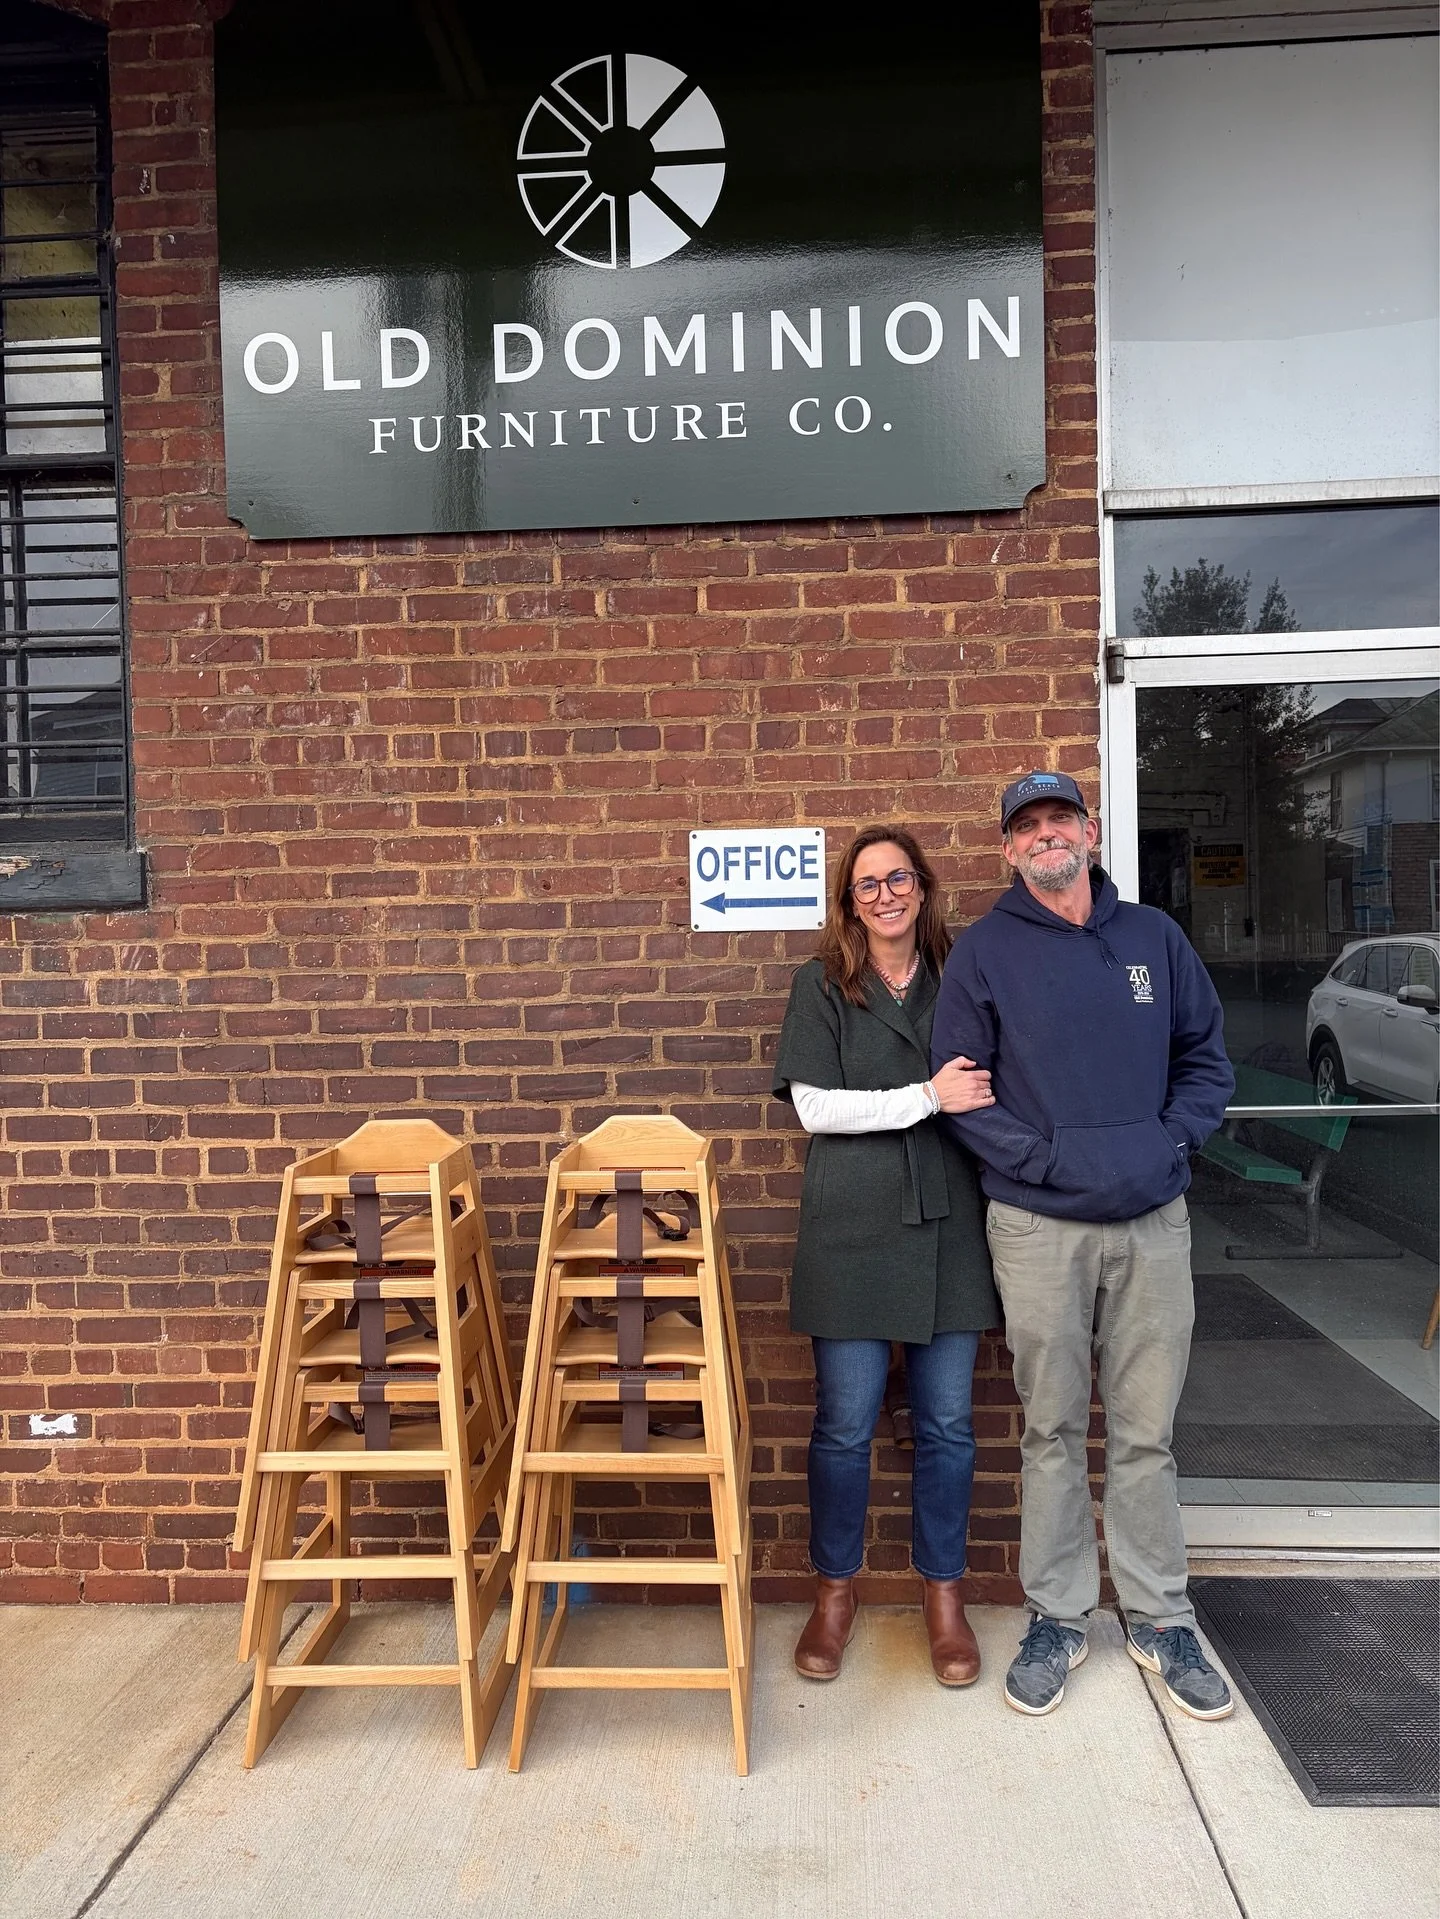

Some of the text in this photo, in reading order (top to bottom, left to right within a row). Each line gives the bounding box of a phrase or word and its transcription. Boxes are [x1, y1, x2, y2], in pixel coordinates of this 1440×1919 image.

[243, 295, 1022, 395] OLD DOMINION
[368, 395, 893, 454] FURNITURE CO.
[696, 845, 819, 882] OFFICE
[1129, 969, 1150, 985] 40
[1131, 984, 1153, 992] YEARS
